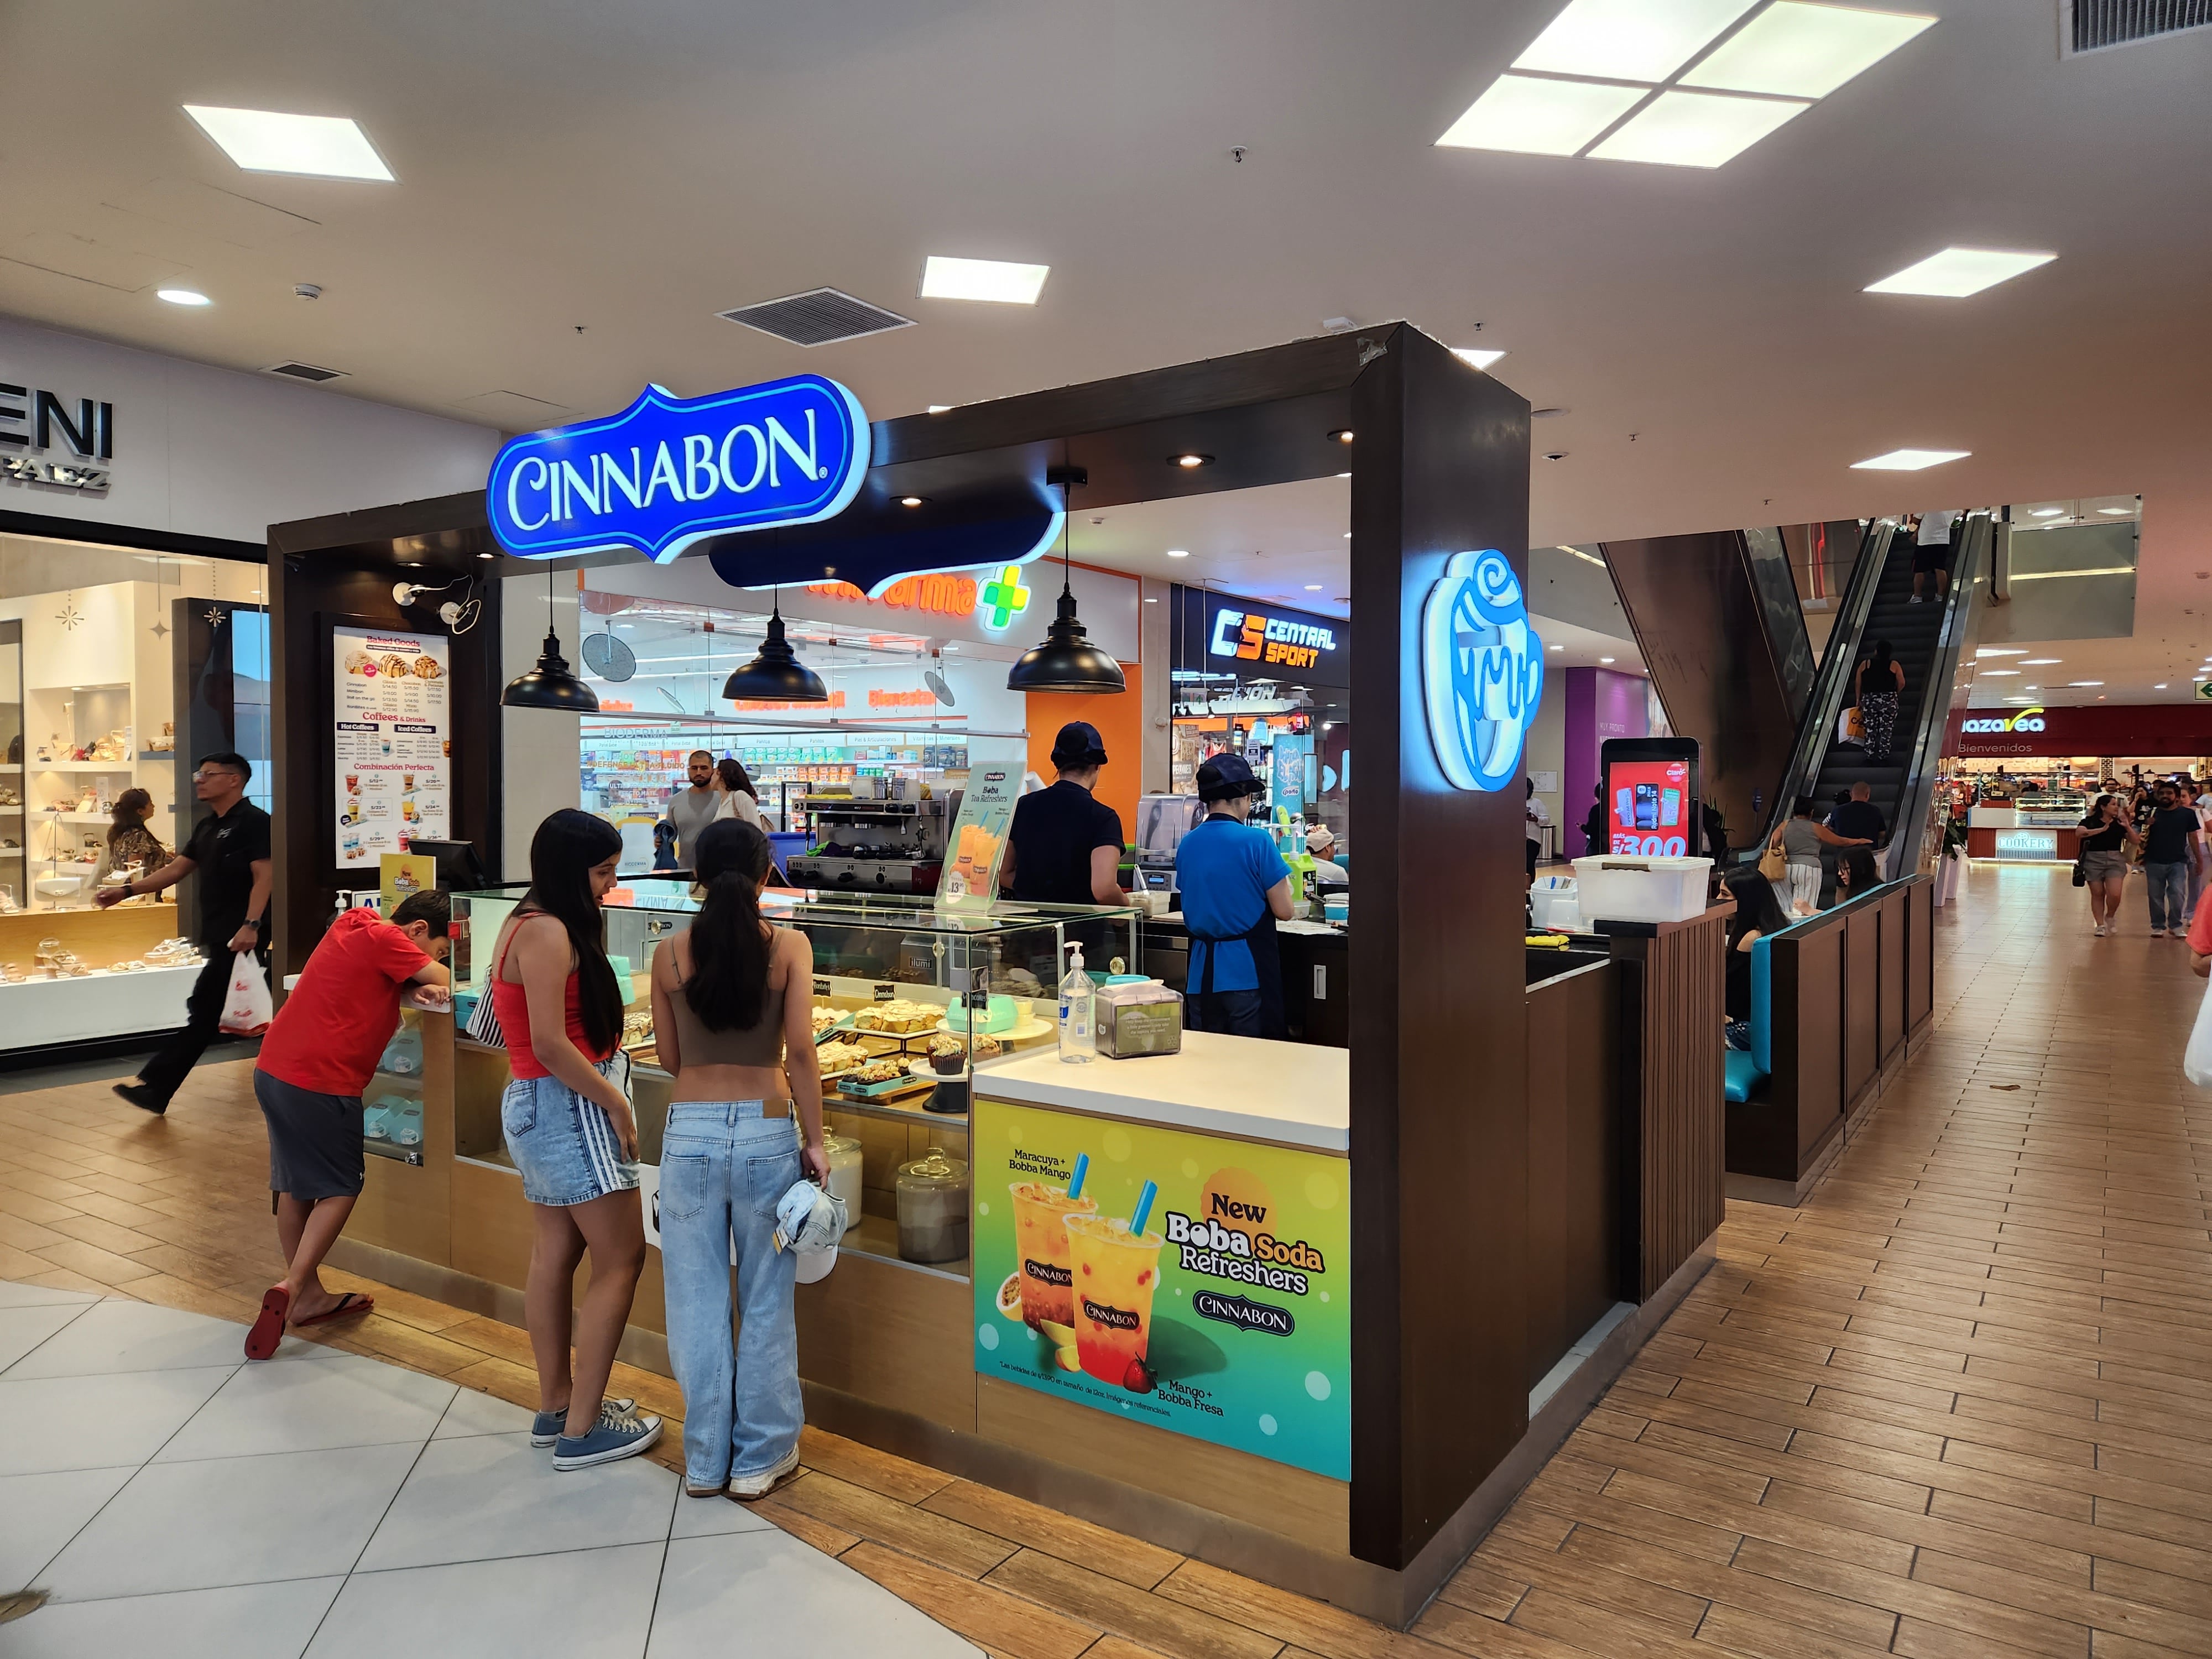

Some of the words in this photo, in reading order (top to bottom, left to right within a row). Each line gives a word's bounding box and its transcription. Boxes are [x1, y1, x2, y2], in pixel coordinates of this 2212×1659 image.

[367, 636, 392, 644] Baked
[1265, 619, 1336, 650] CENTRAL
[1265, 642, 1318, 669] SPORT
[363, 712, 398, 721] Coffees
[604, 728, 668, 739] BIODERMA
[1959, 744, 2032, 752] Bienvenidos
[1999, 838, 2053, 848] COOKERY
[911, 958, 930, 968] ilumi
[875, 989, 894, 999] Cinnabon
[1015, 1149, 1059, 1166] Maracuya
[1009, 1159, 1038, 1173] Bobba
[1040, 1165, 1071, 1181] Mango
[1211, 1193, 1266, 1223] New
[1167, 1214, 1251, 1257] Boba
[1256, 1235, 1323, 1271] Soda
[1181, 1245, 1306, 1293] Refreshers
[1086, 1304, 1136, 1326] CINNABON
[1199, 1296, 1287, 1331] CINNABON
[1011, 1363, 1030, 1375] bebidas
[1063, 1380, 1084, 1391] tamaño
[1106, 1392, 1134, 1406] Imágenes
[1169, 1380, 1205, 1399] Mango
[1158, 1389, 1192, 1408] Bobba
[1194, 1400, 1224, 1417] Fresa
